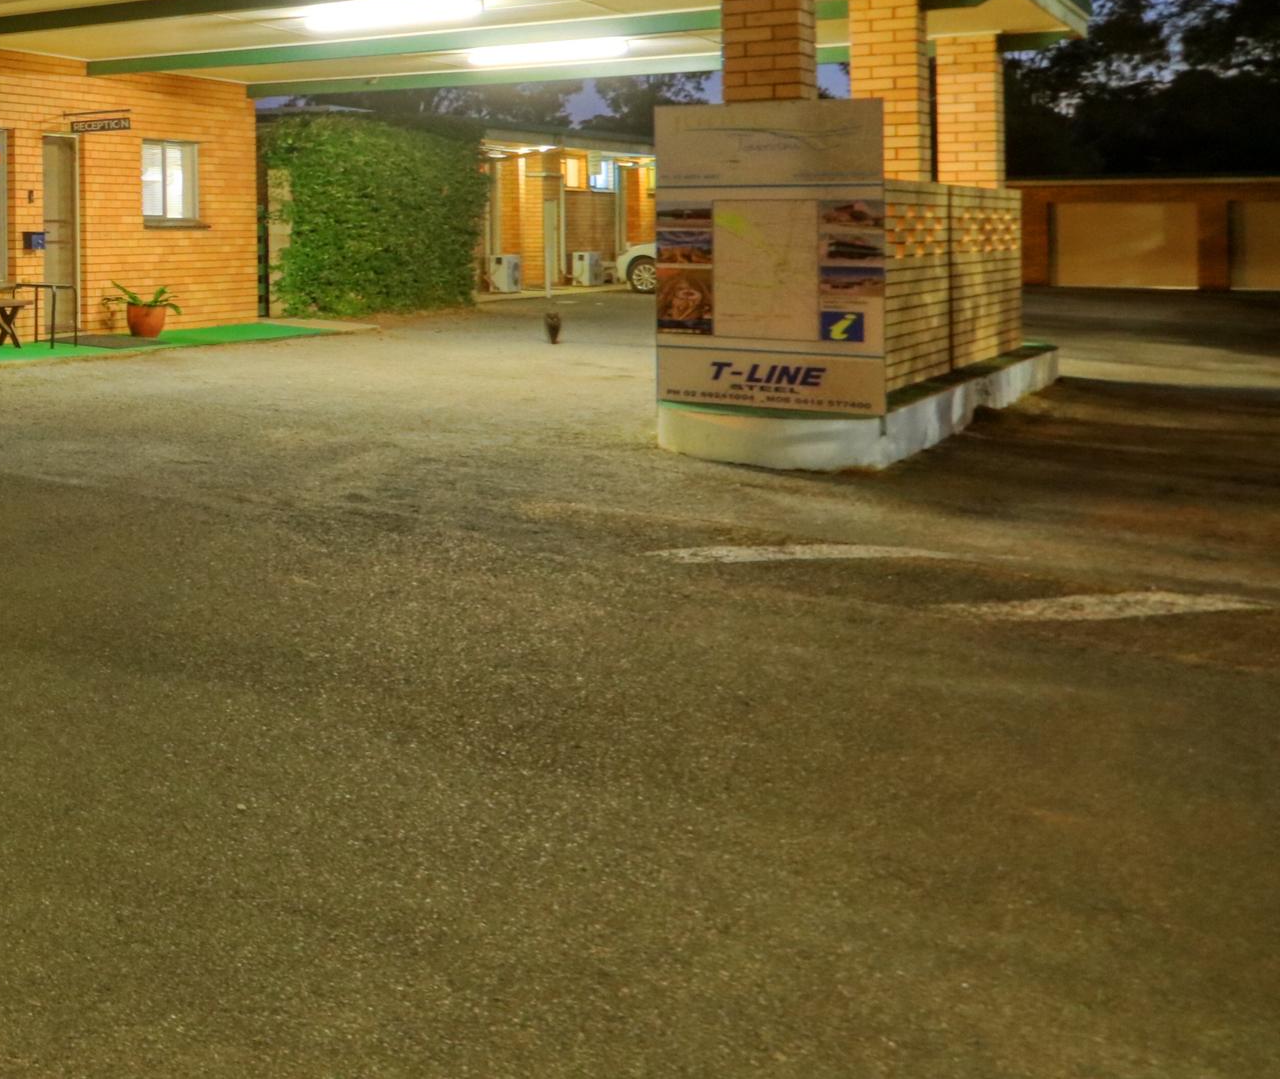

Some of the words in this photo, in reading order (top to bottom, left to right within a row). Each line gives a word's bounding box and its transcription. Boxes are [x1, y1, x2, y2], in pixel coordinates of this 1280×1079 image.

[73, 119, 129, 131] RECEPTION
[710, 362, 827, 387] T-LINE
[730, 383, 800, 394] STEEL
